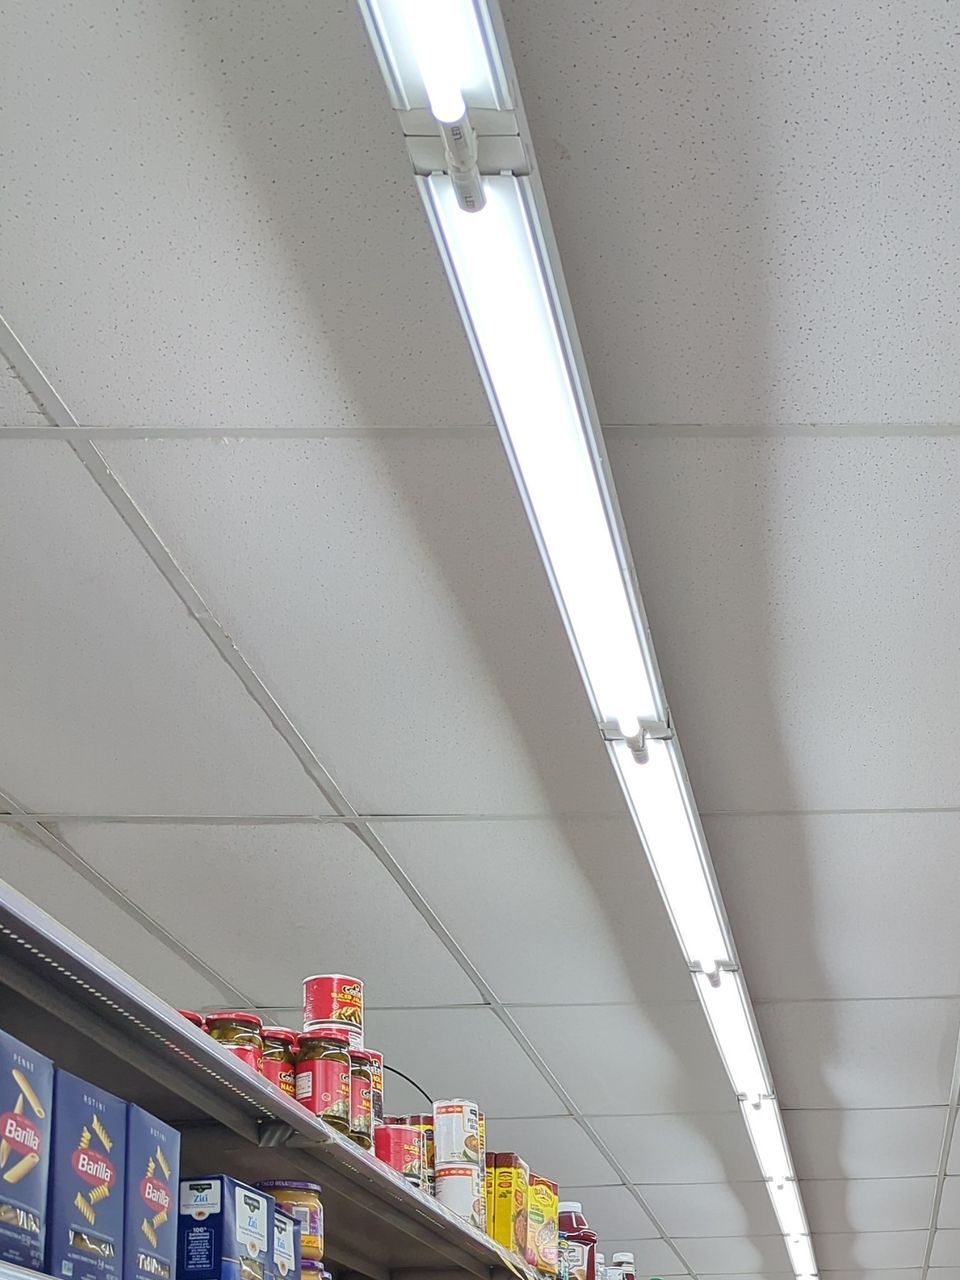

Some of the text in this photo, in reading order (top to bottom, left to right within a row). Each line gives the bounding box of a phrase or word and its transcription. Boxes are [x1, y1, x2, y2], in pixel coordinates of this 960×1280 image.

[280, 1081, 295, 1091] NAC
[4, 1118, 40, 1150] Barilla
[78, 1157, 113, 1184] Barilla
[144, 1182, 170, 1209] Barilla
[193, 1194, 208, 1204] Ziti
